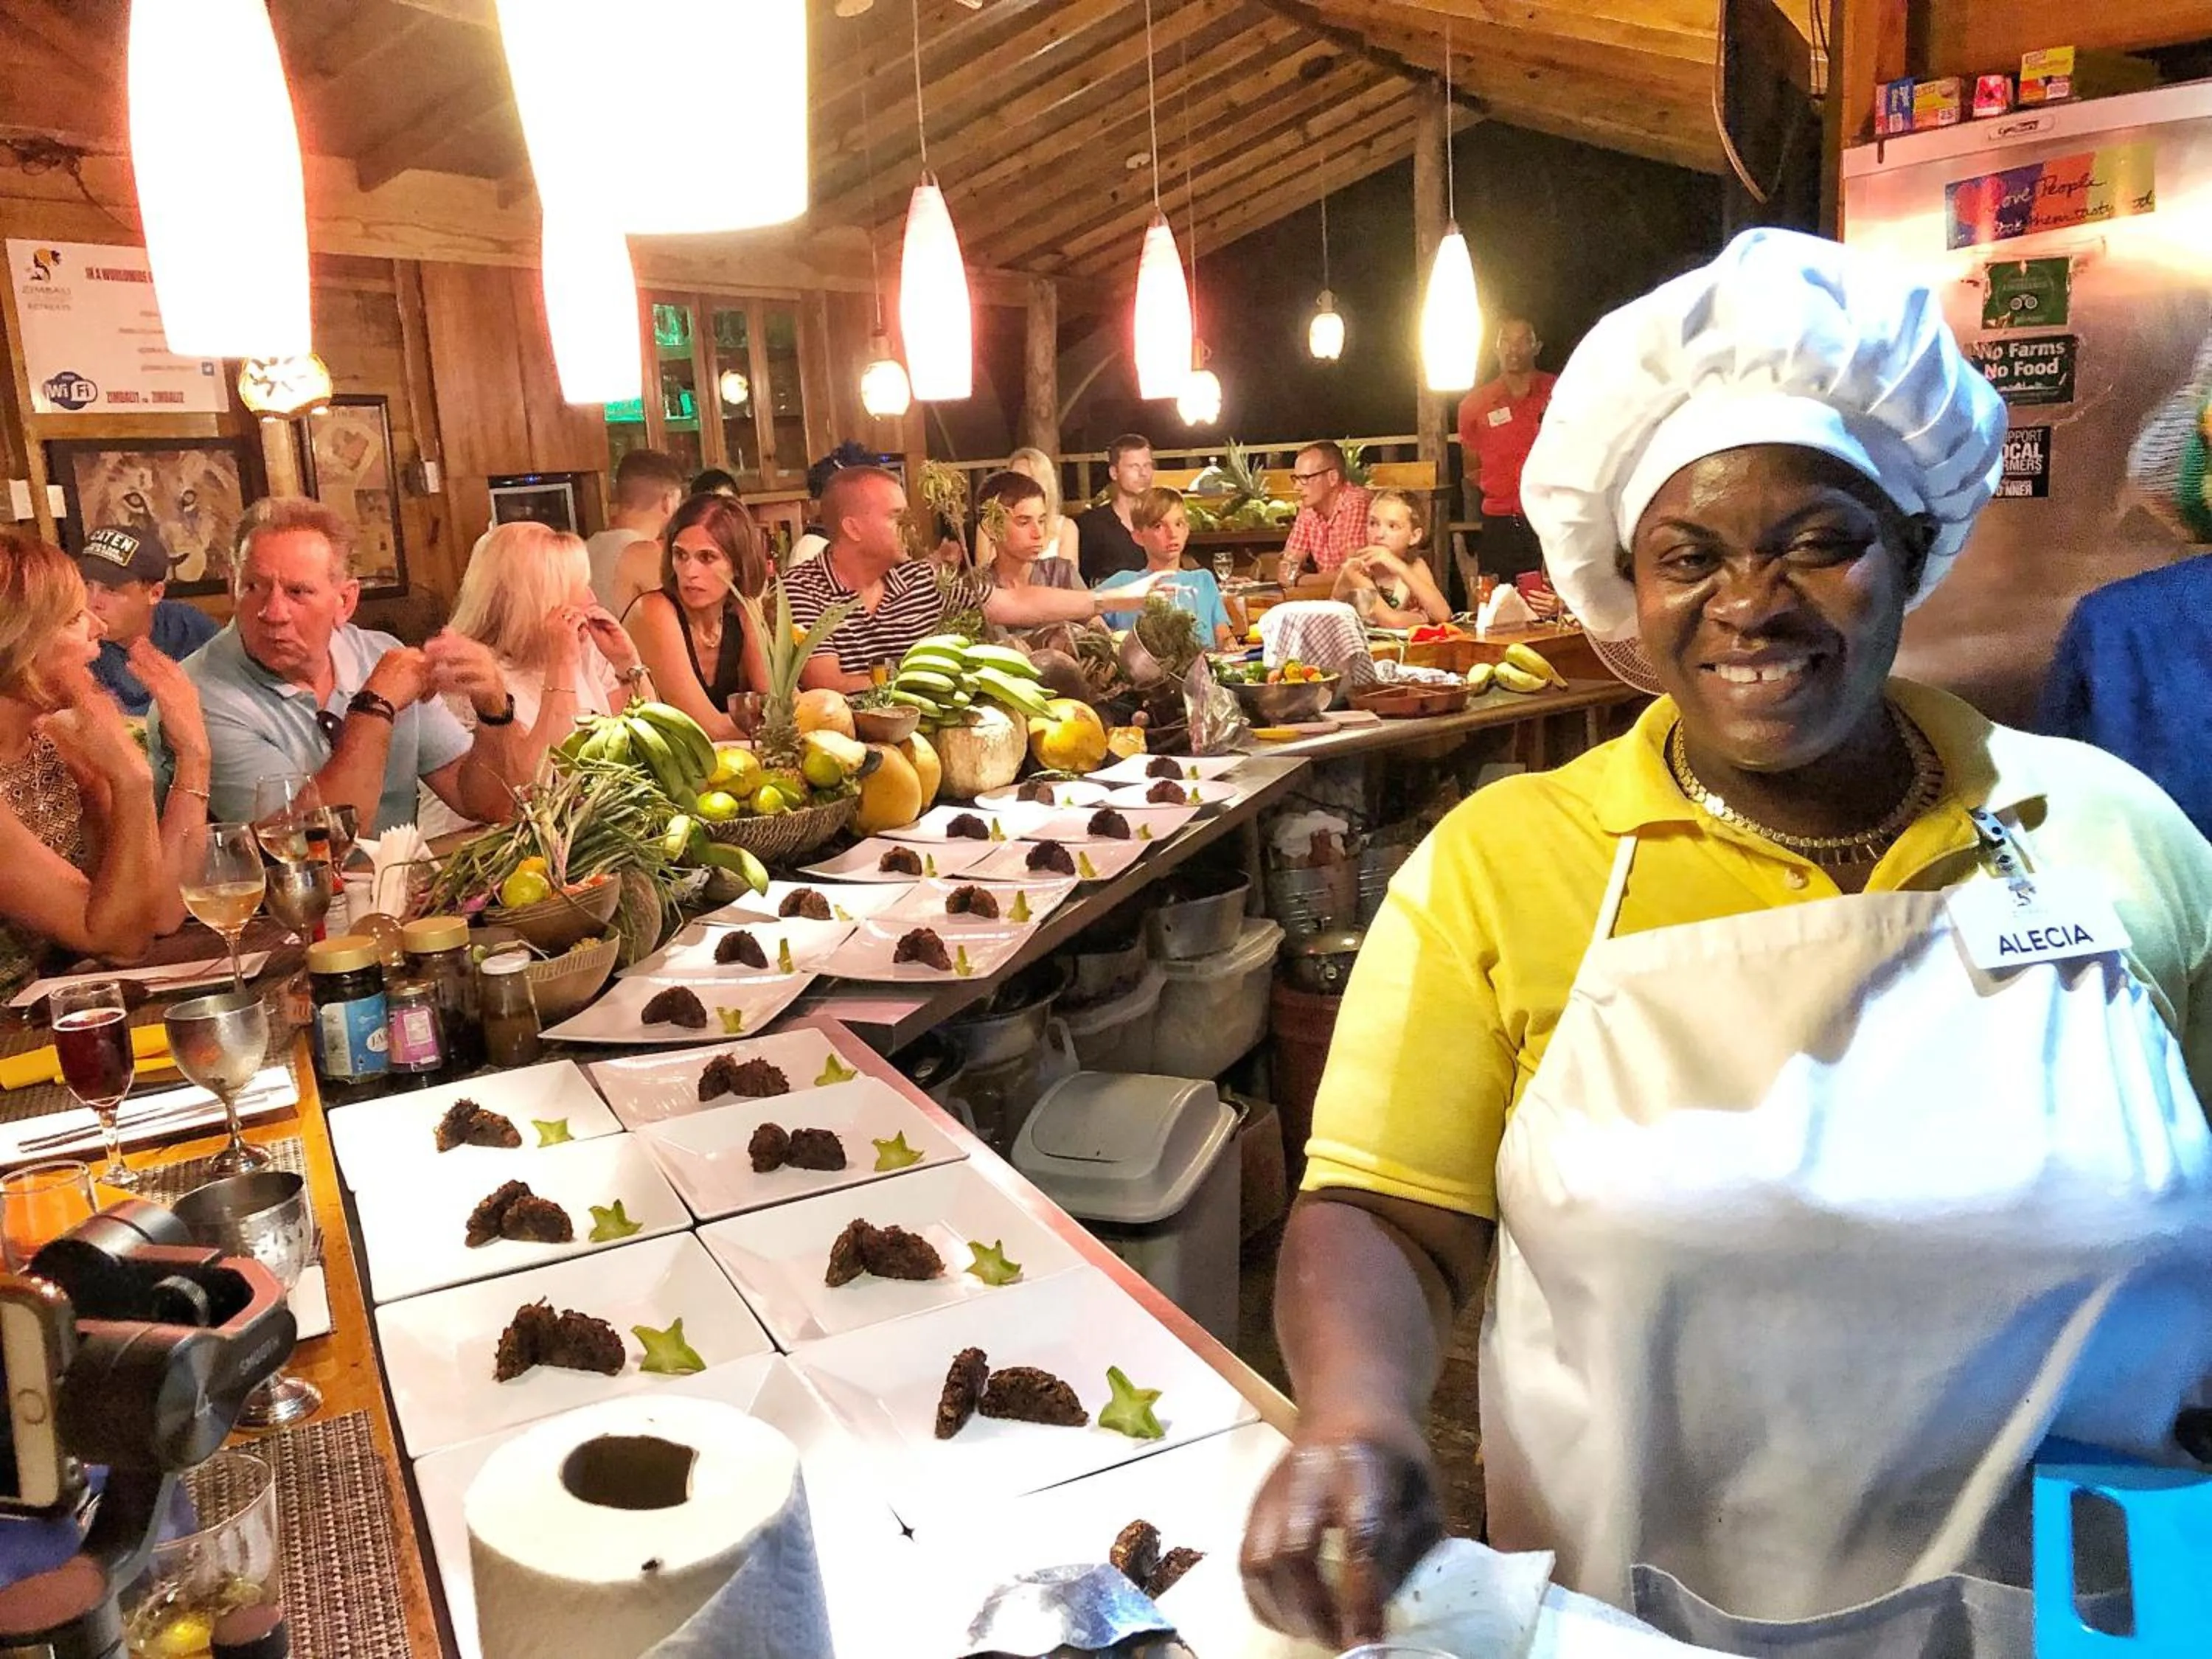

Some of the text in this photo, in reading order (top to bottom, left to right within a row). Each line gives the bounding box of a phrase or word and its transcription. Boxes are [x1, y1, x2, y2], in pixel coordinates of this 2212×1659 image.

[1975, 341, 2066, 361] No Farms
[1983, 356, 2060, 380] No Food
[2004, 429, 2044, 442] PPORT
[2001, 442, 2045, 459] OCAL
[1999, 923, 2094, 956] ALECIA
